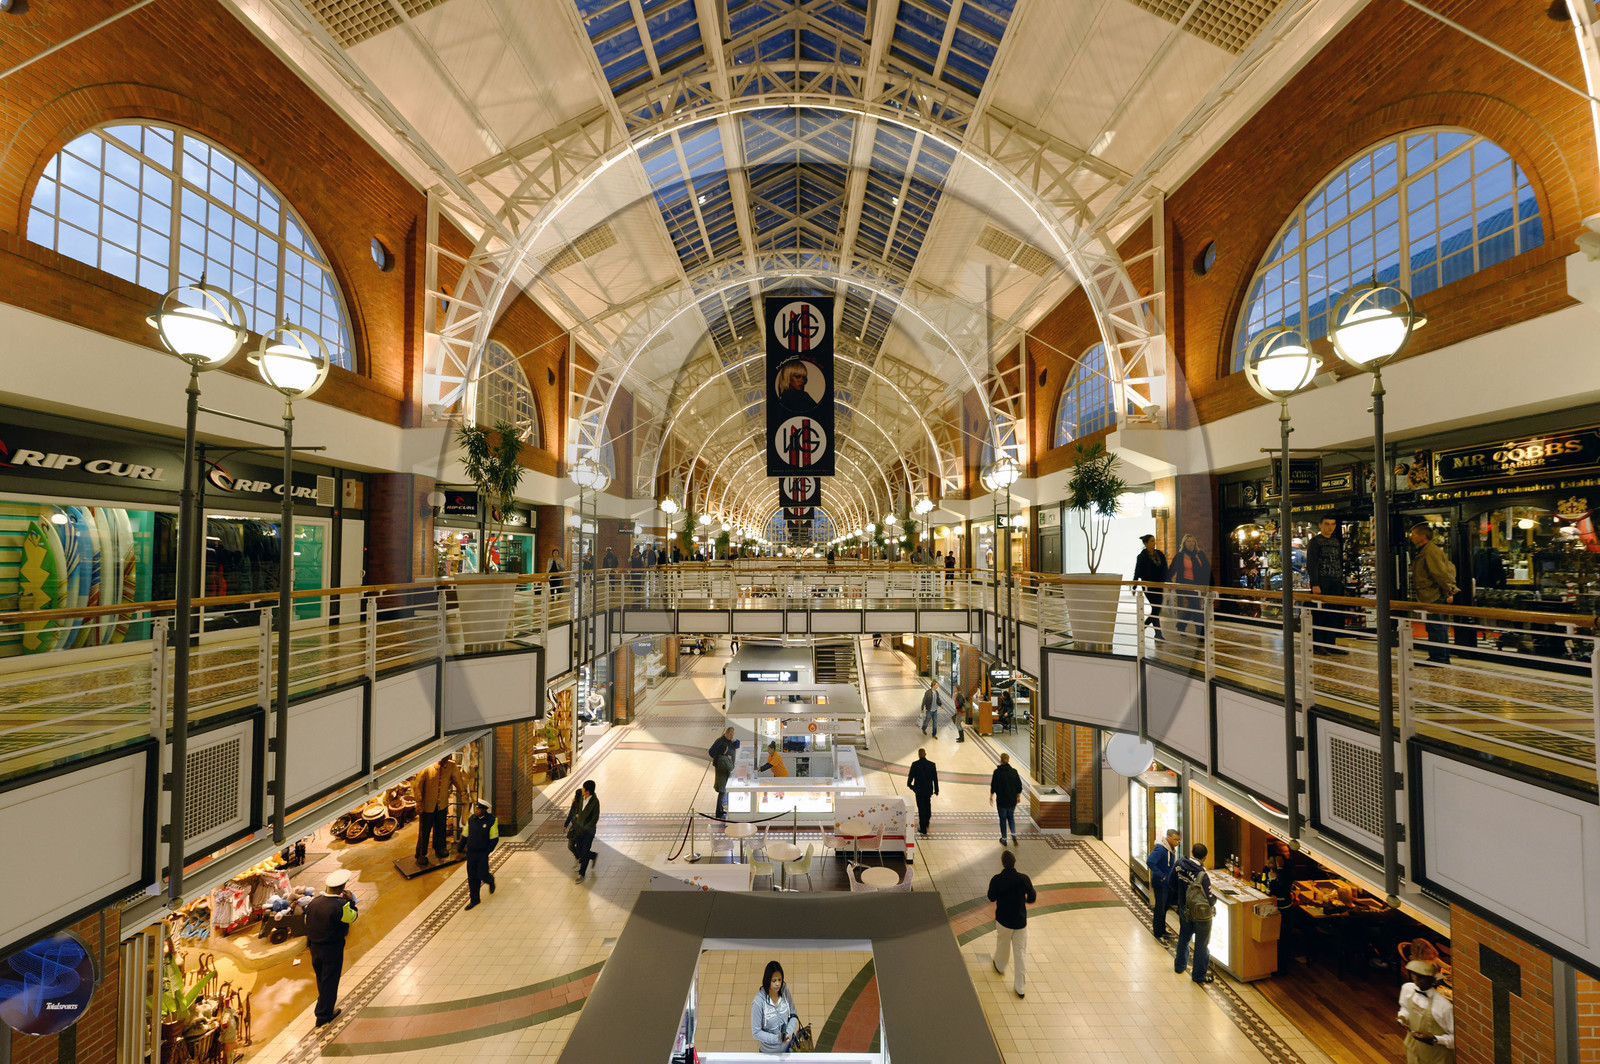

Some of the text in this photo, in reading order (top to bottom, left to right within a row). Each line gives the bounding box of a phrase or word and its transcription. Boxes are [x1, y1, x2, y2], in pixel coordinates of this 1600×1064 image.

[1452, 440, 1583, 470] MR COBBS
[10, 448, 166, 482] RIP CURL
[1481, 458, 1546, 472] THE BARBER
[233, 478, 272, 494] RIP
[1420, 493, 1434, 501] The
[1435, 491, 1451, 501] City
[1453, 490, 1462, 499] of
[1464, 488, 1494, 498] London
[1496, 483, 1556, 495] Brushmakers
